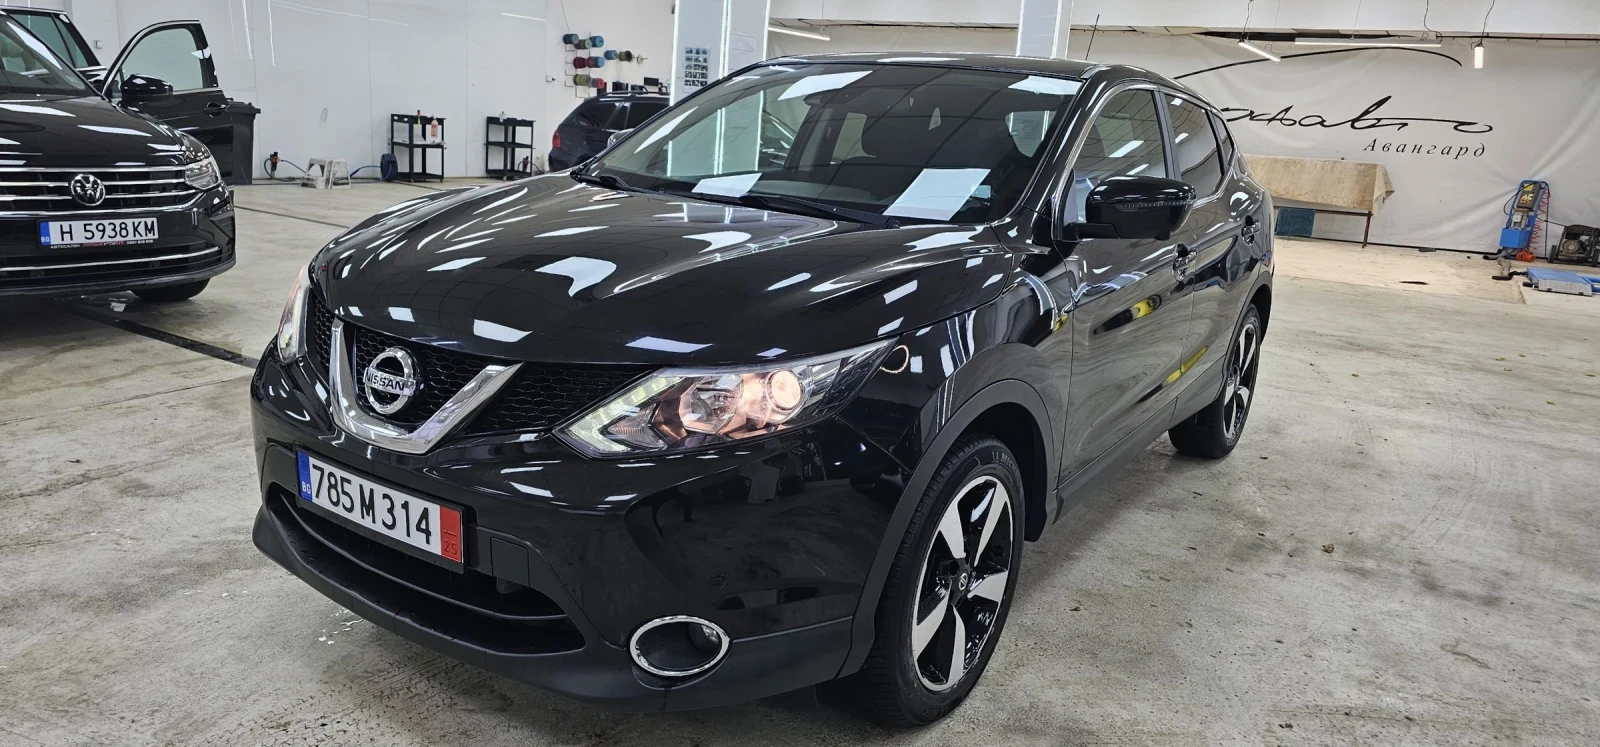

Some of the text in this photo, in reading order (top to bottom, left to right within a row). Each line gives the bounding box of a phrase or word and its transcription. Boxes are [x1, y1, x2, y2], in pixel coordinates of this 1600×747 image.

[1363, 138, 1486, 160] Авангард
[366, 371, 405, 391] NISSAN
[301, 481, 312, 495] BG
[443, 538, 457, 555] 25
